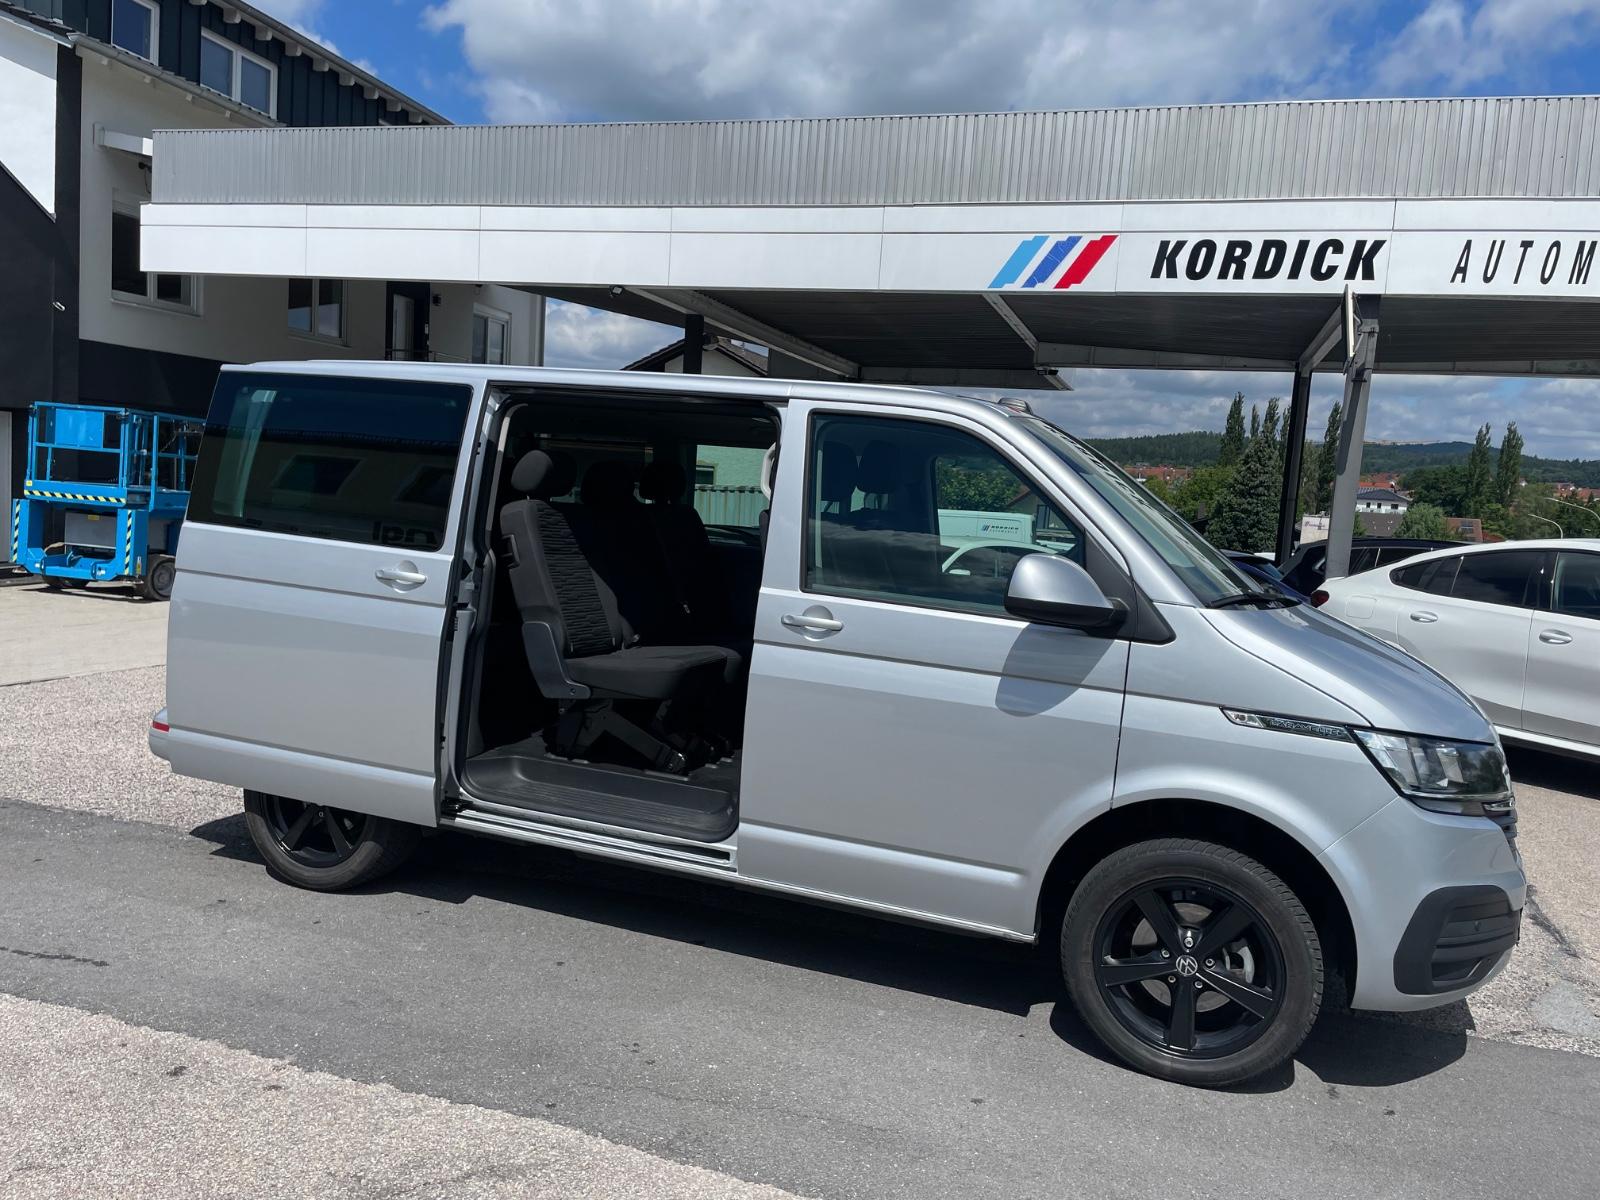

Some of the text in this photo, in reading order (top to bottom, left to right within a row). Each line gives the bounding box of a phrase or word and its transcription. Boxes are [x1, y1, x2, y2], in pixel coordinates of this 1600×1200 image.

[1151, 239, 1598, 284] KORDICK AUTOM
[1176, 955, 1198, 976] VW
